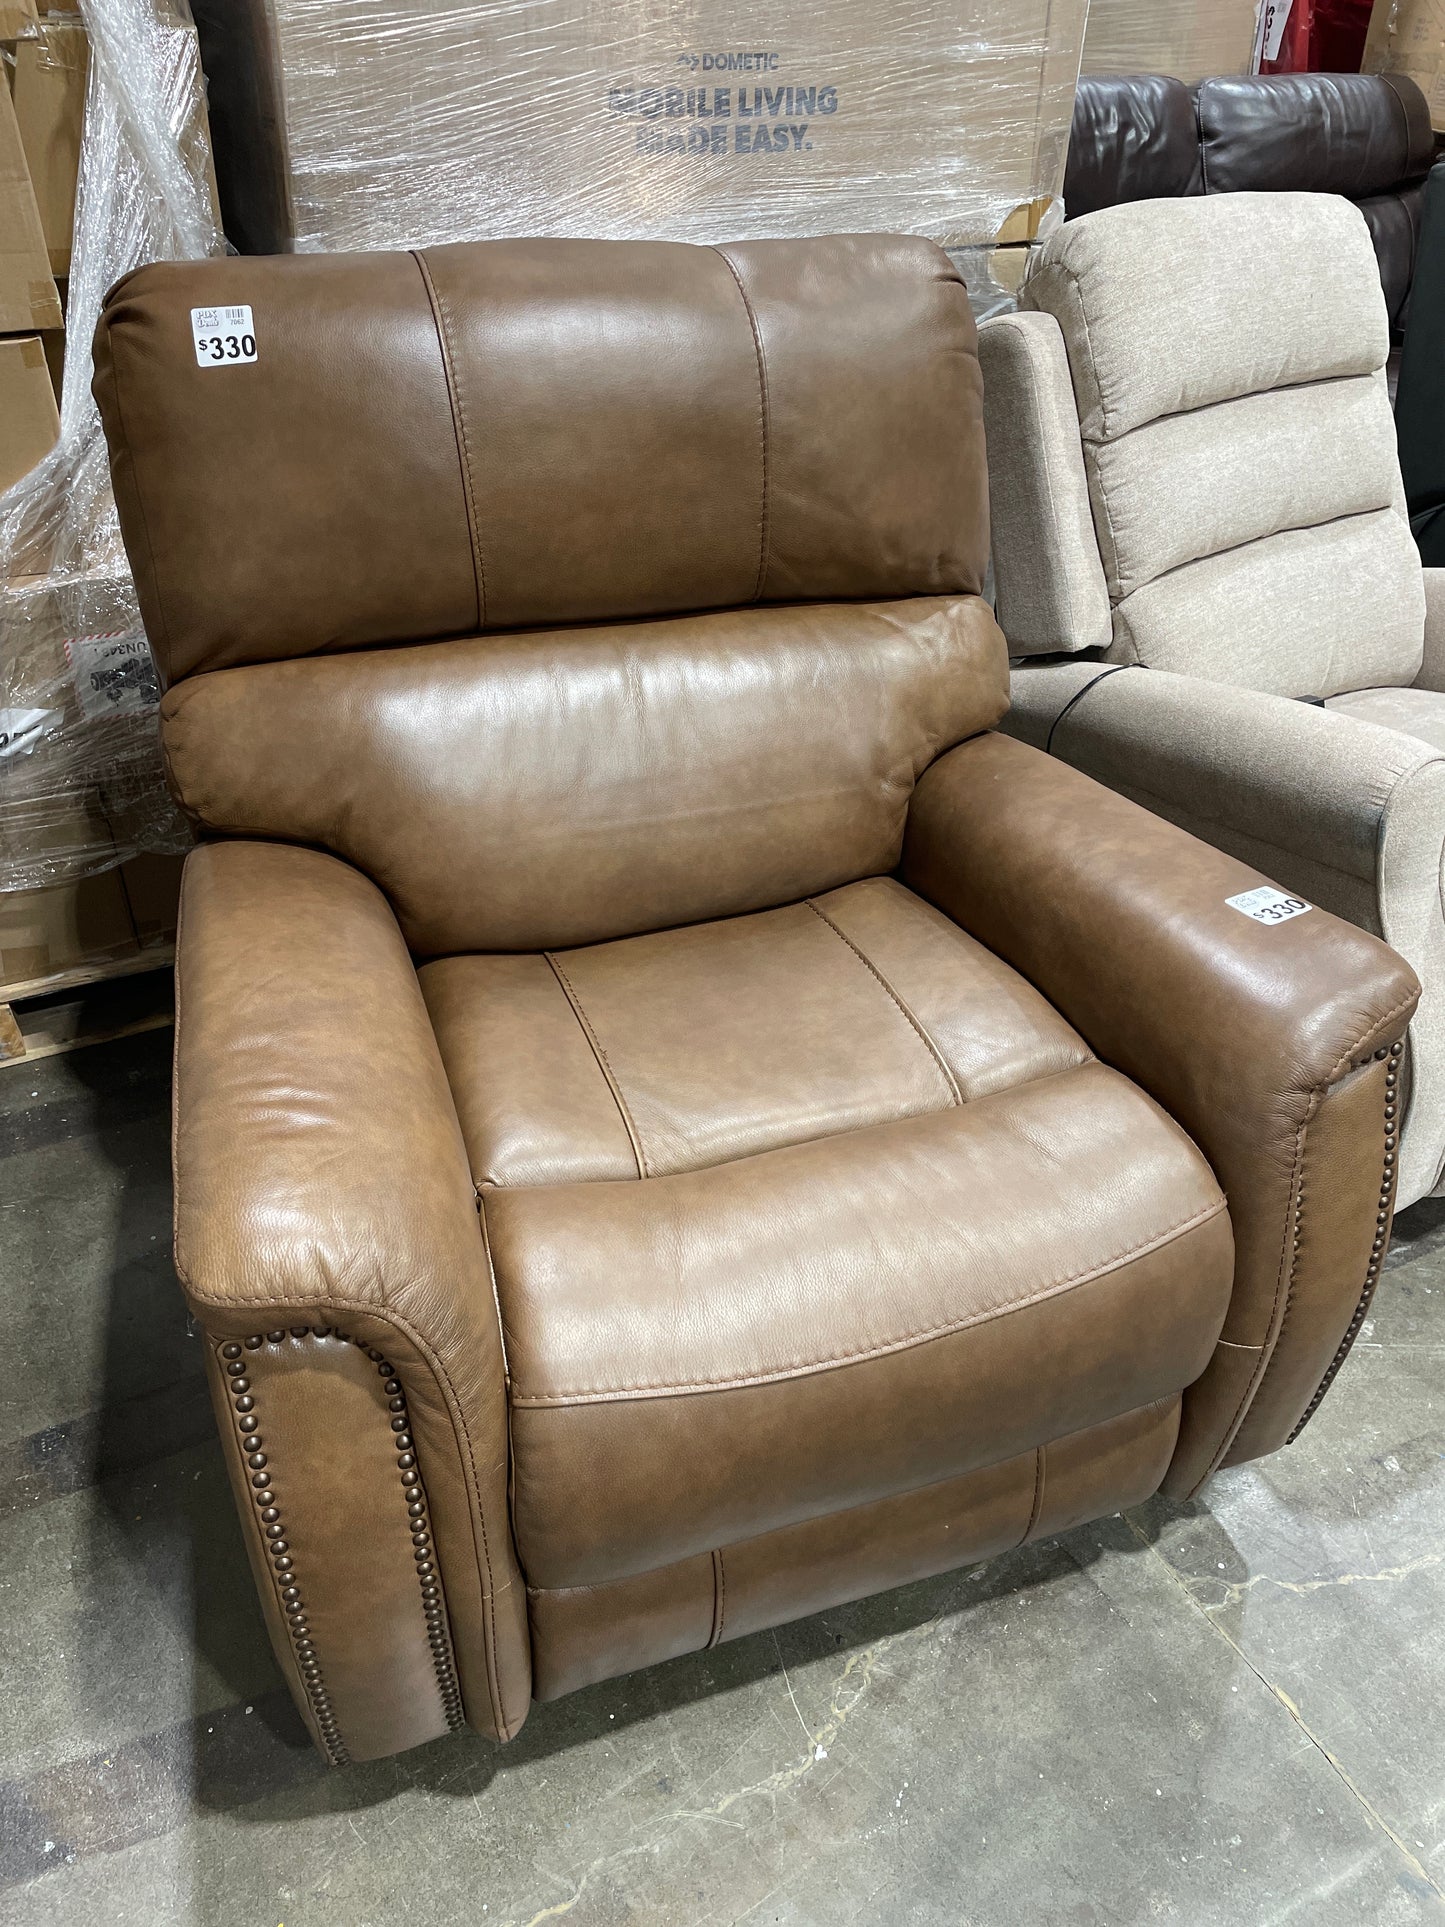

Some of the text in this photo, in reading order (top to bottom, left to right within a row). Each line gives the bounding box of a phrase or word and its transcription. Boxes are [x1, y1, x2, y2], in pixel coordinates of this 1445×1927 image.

[702, 53, 779, 71] DOMETIC
[609, 85, 838, 118] MOBILE LIVING
[636, 123, 812, 155] MADE EASY.
[198, 334, 256, 360] $330
[1253, 899, 1306, 919] $330
